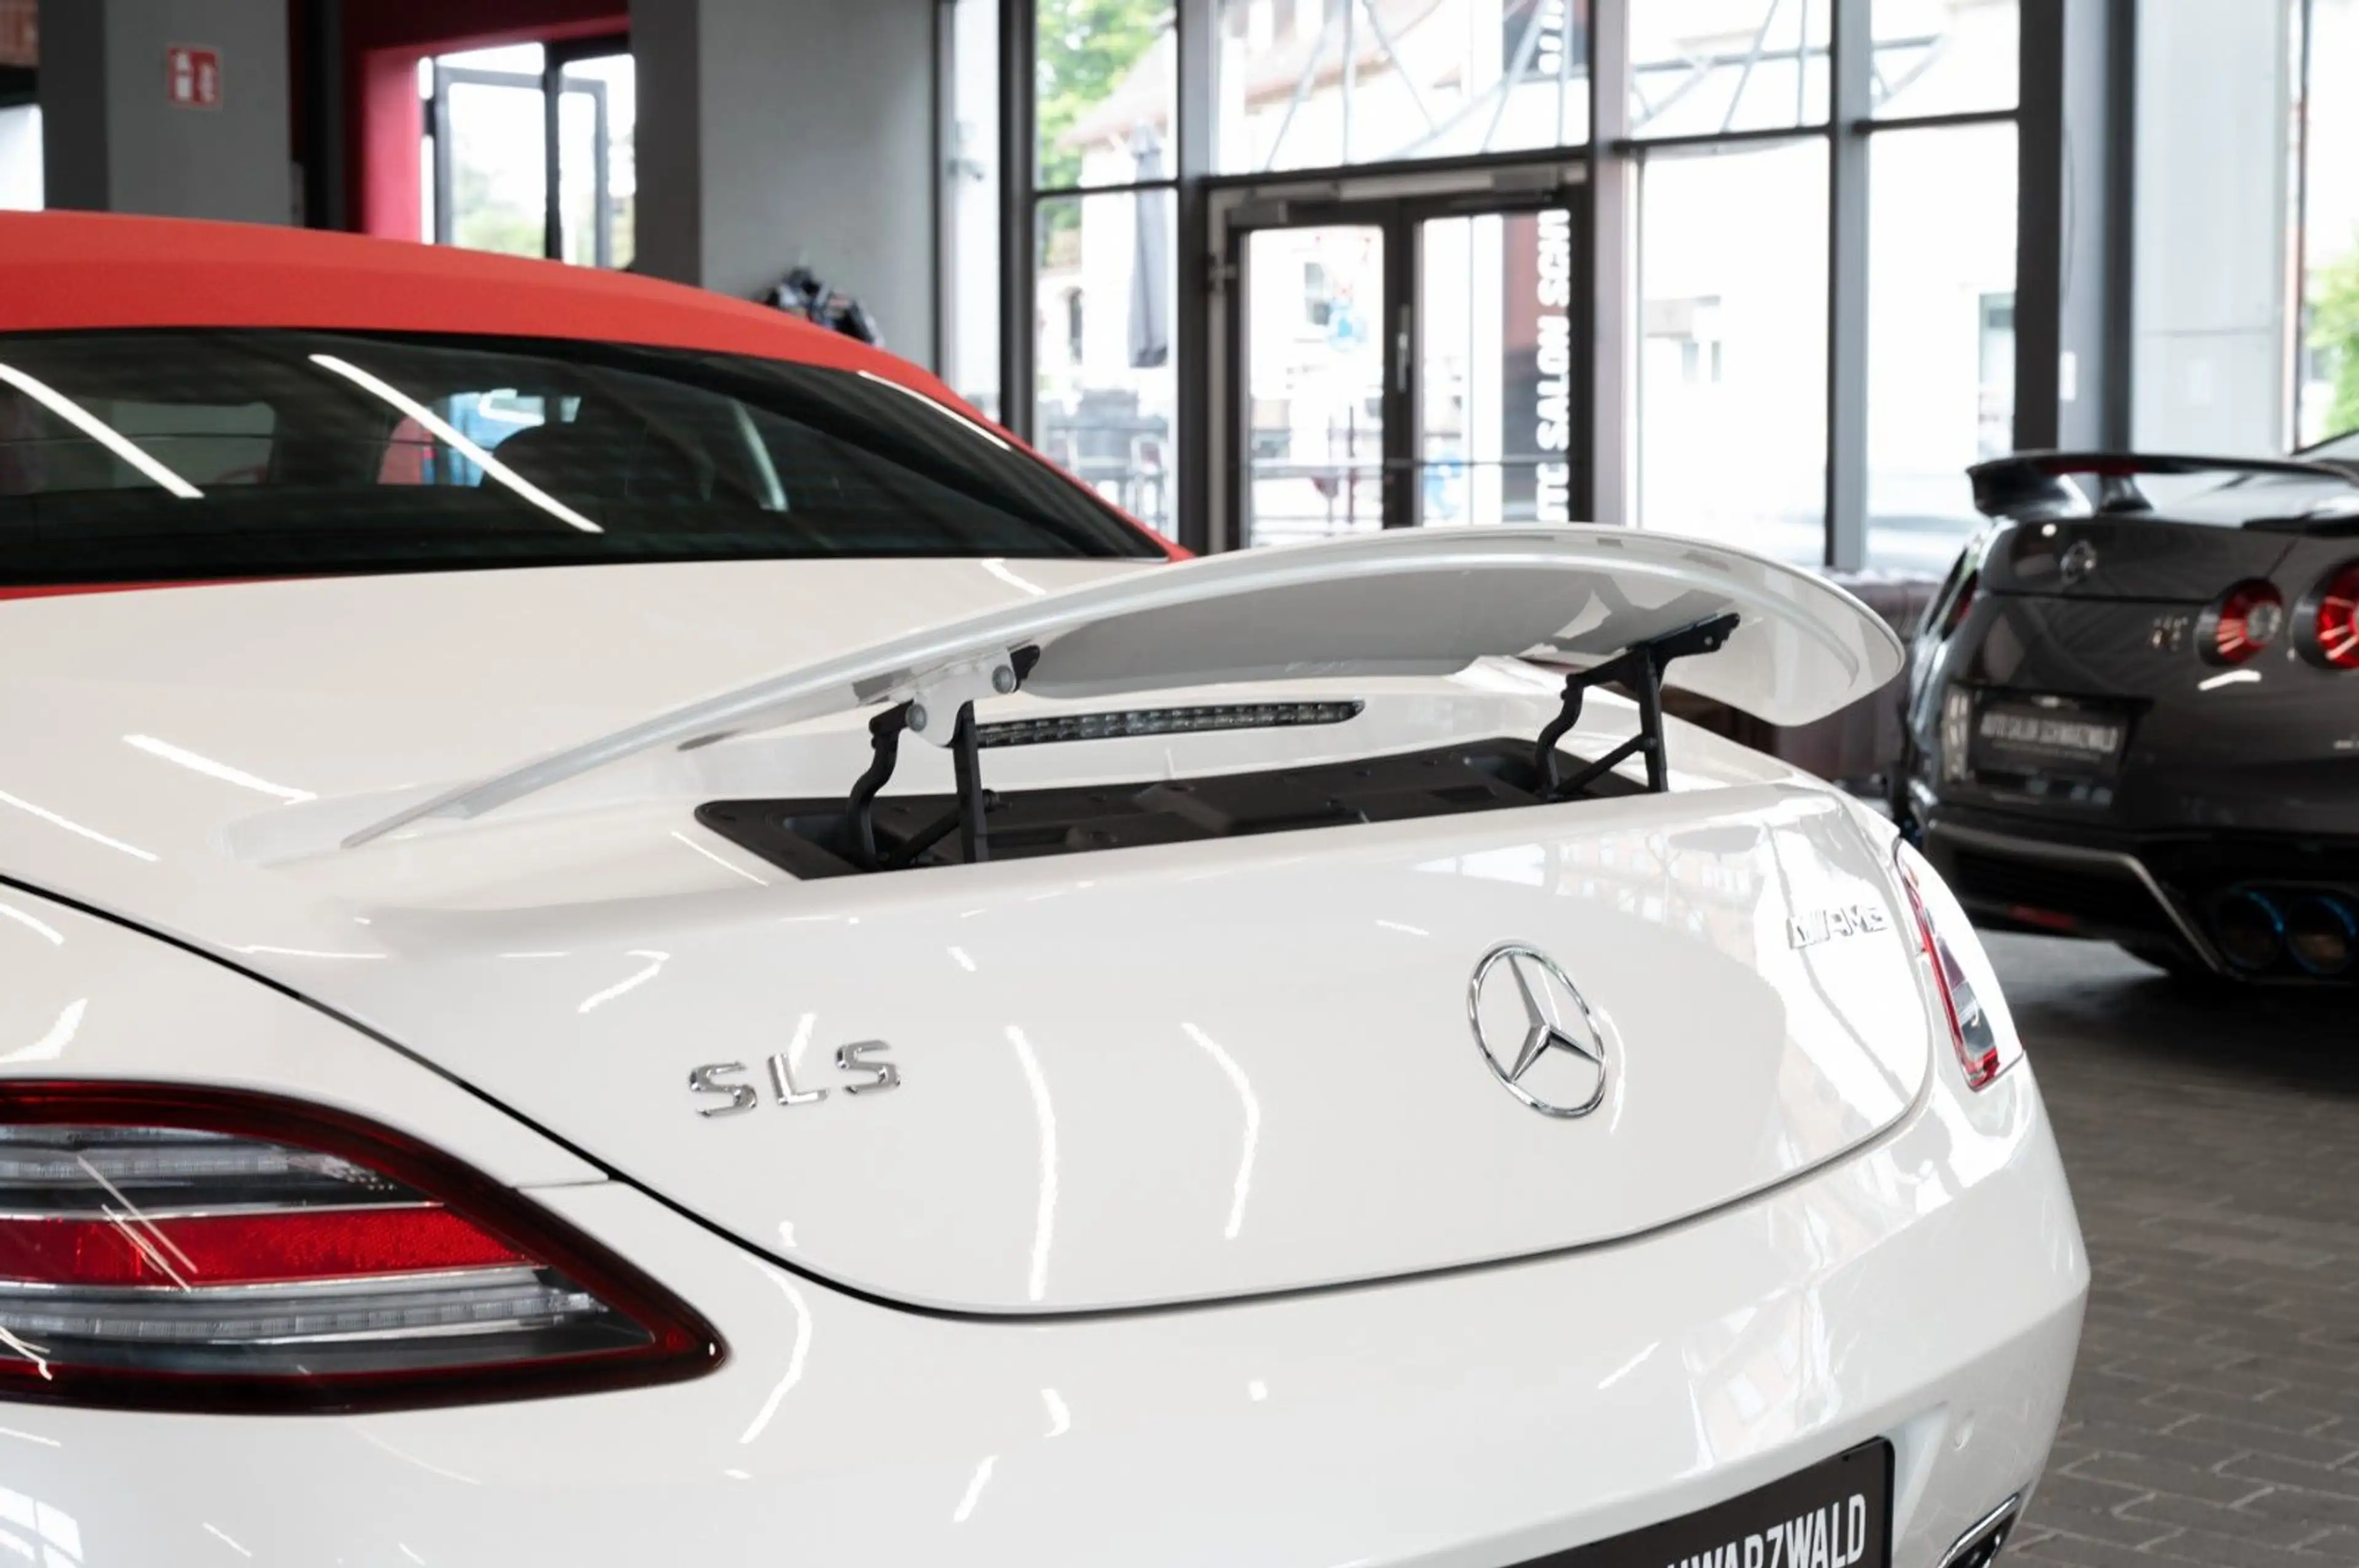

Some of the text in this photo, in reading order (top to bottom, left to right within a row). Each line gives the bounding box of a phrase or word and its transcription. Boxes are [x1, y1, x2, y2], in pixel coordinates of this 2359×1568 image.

[1536, 315, 1570, 451] SALON
[689, 1040, 901, 1118] SLS
[1667, 1493, 1866, 1568] ZWALD
